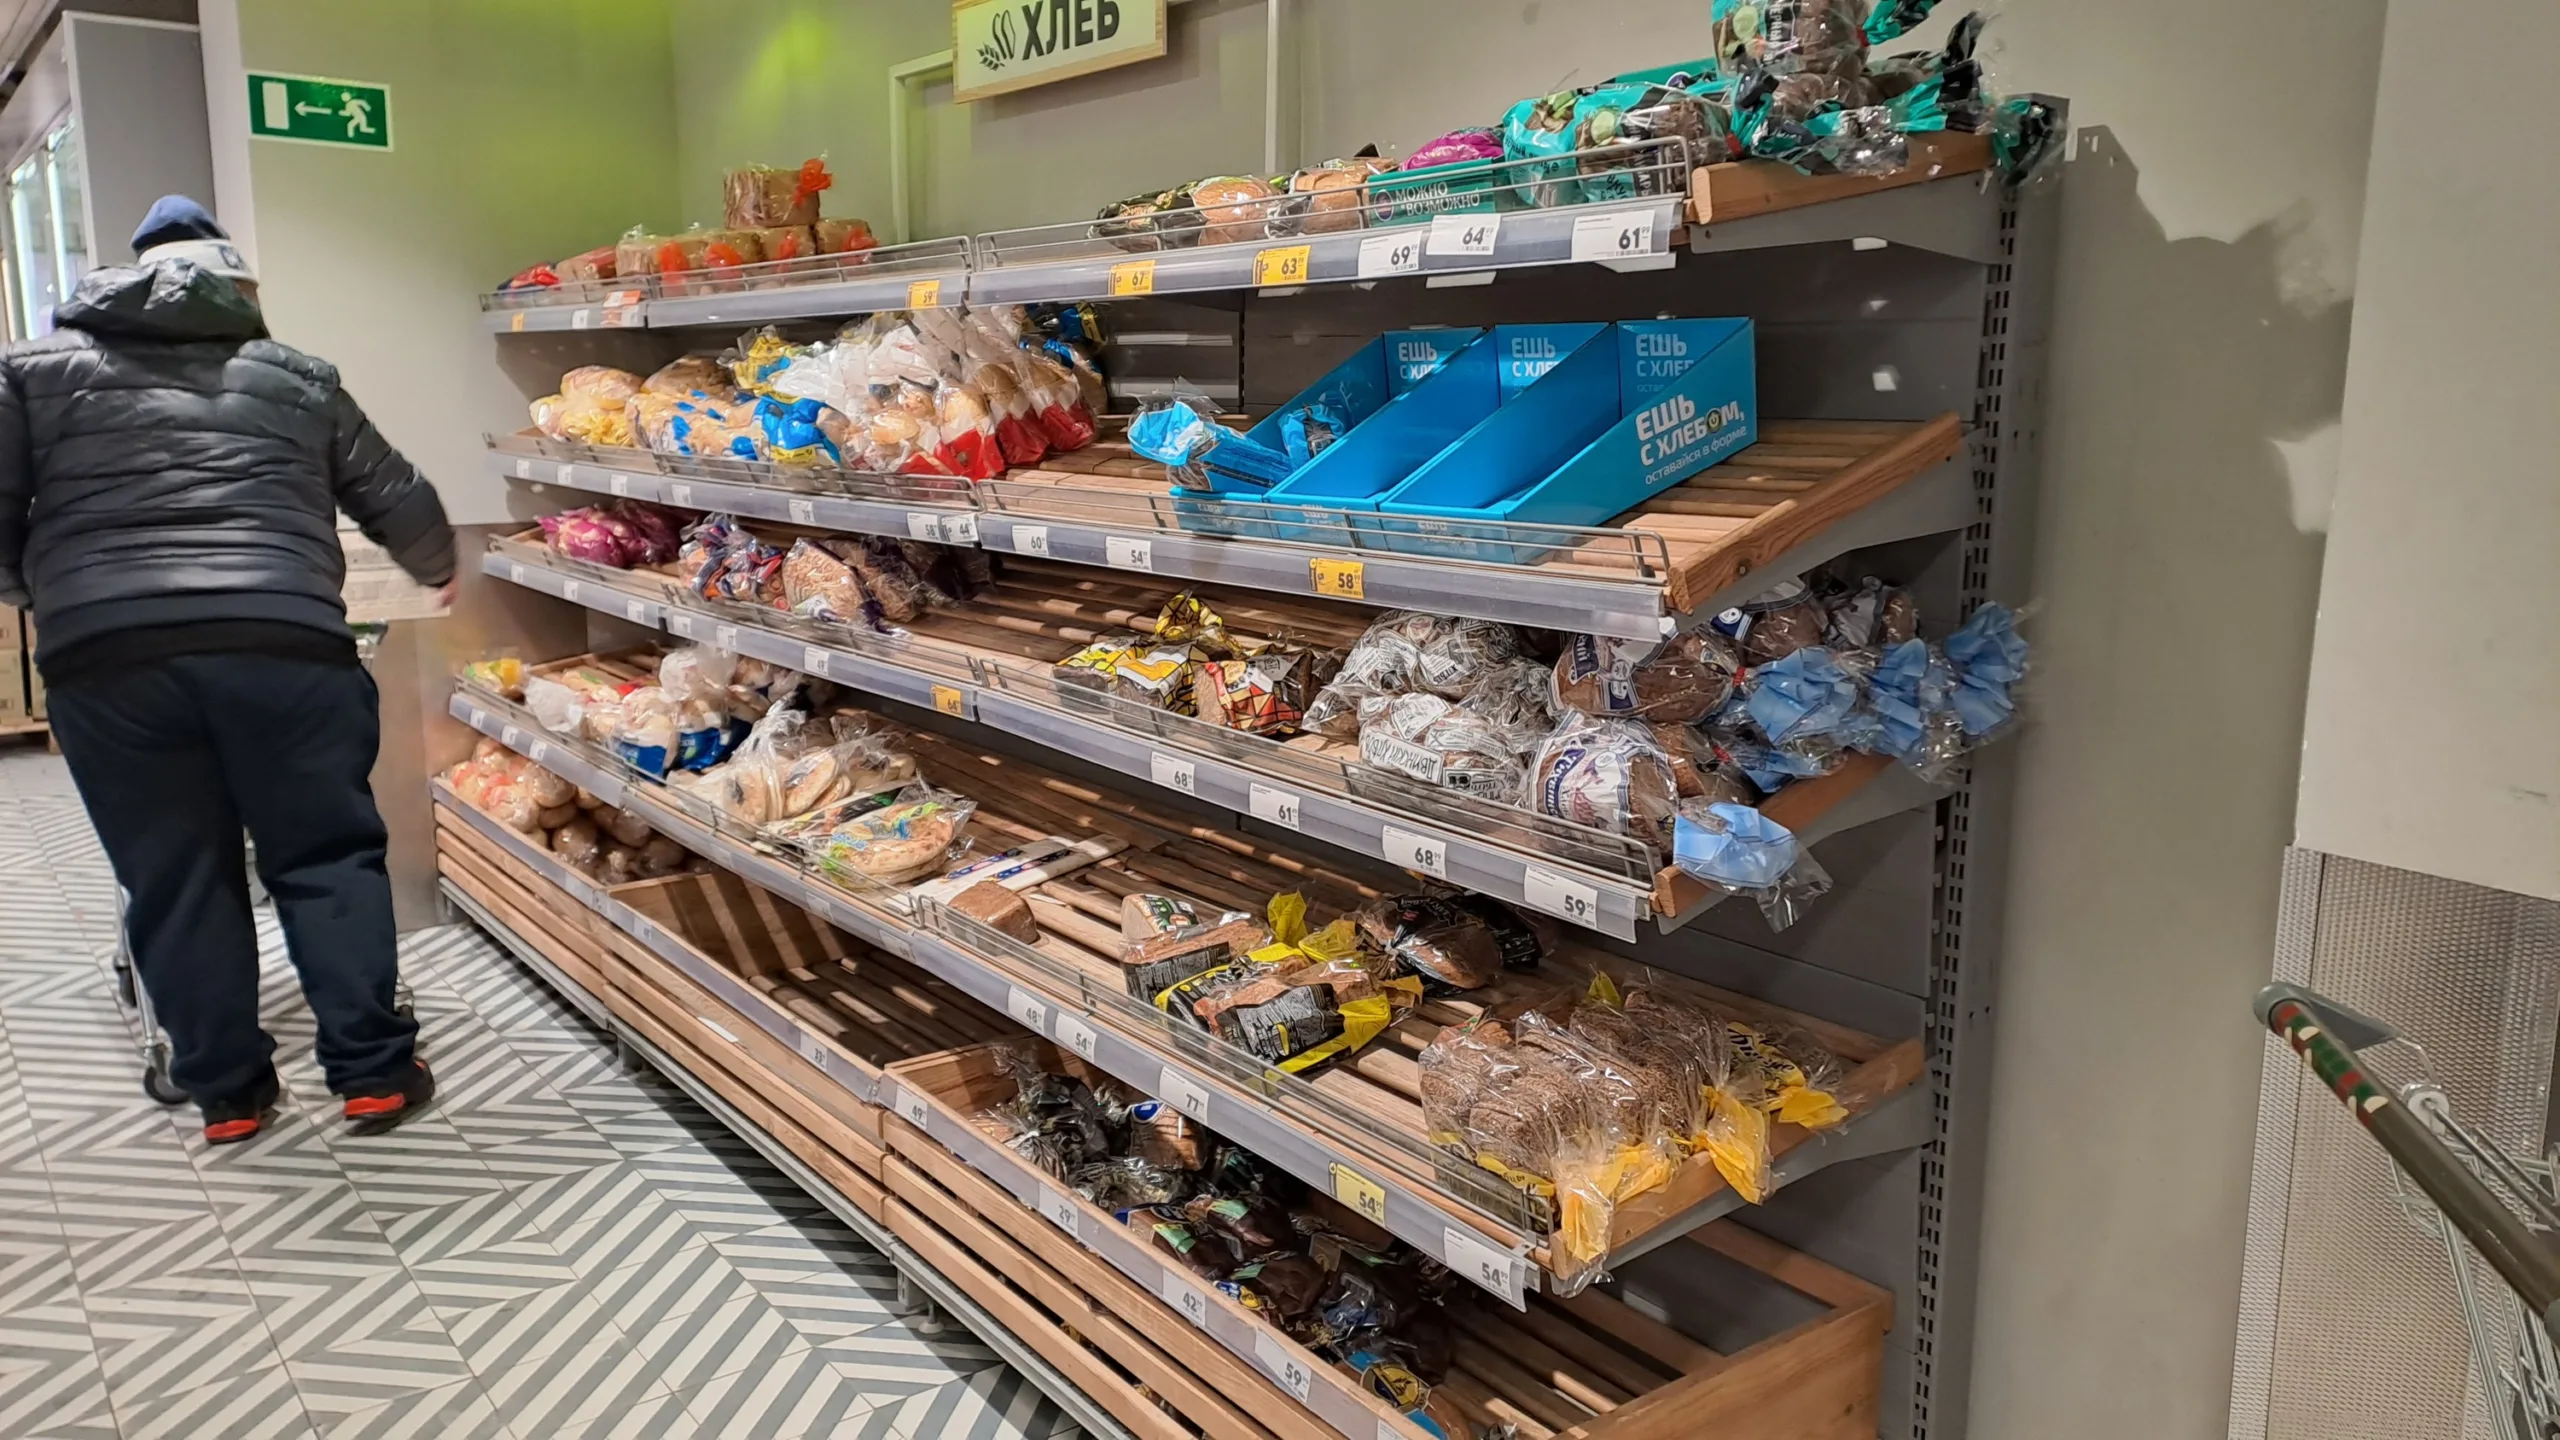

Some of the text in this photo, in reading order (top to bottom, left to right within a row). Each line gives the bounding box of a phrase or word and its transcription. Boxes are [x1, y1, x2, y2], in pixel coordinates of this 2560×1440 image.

[1022, 0, 1120, 61] ХЛЕБ
[1396, 181, 1448, 203] МОЖНО
[1405, 193, 1480, 216] ВОЗМОЖНО
[1462, 226, 1485, 245] 64
[1618, 227, 1640, 250] 61
[1281, 257, 1297, 275] 63
[1390, 245, 1411, 266] 69
[1132, 270, 1144, 287] 67
[1398, 341, 1438, 362] ЕШЬ
[1511, 337, 1557, 359] ЕШЬ
[1635, 333, 1687, 357] ЕШЬ
[1512, 361, 1522, 377] С
[1636, 360, 1647, 377] С
[1635, 394, 1696, 442] ЕШЬ
[1640, 443, 1655, 467] С
[1645, 451, 1702, 485] оставайся
[1711, 425, 1748, 454] форме
[1030, 536, 1042, 550] 60
[1131, 549, 1144, 565] 54
[1338, 571, 1354, 590] 58
[1174, 770, 1188, 788] 68
[1278, 804, 1292, 822] 61
[1414, 846, 1434, 866] 68
[1564, 894, 1586, 917] 59
[1026, 1007, 1038, 1024] 48
[1074, 1031, 1087, 1051] 54
[911, 1104, 923, 1121] 49
[1359, 1190, 1377, 1214] 54
[1059, 1204, 1071, 1223] 29
[1481, 1261, 1502, 1288] 54
[1183, 1291, 1197, 1312] 42
[1284, 1361, 1302, 1386] 59
